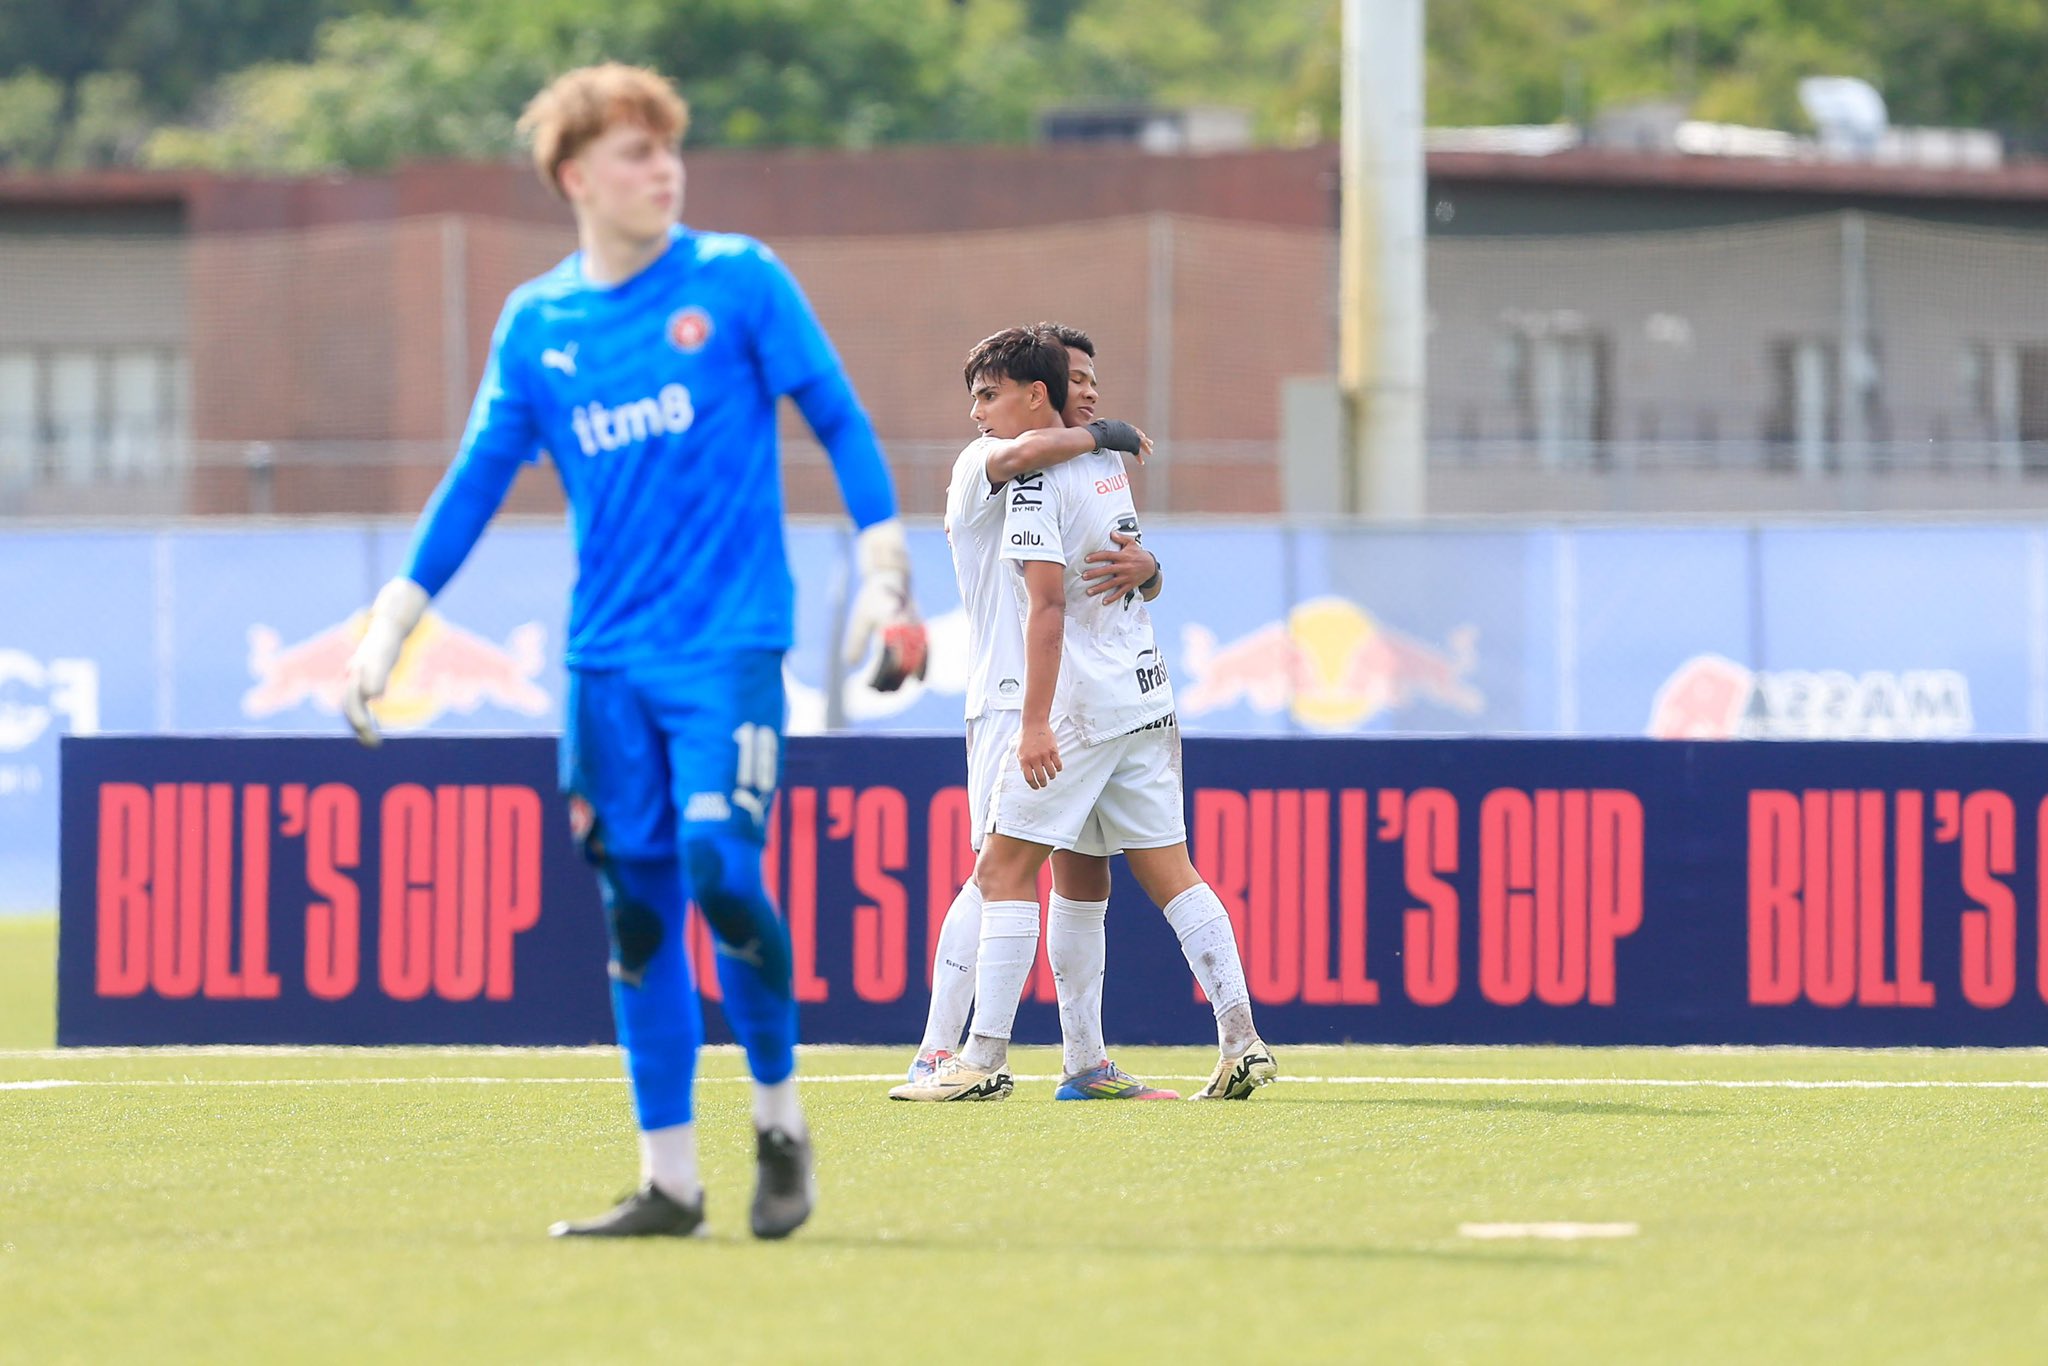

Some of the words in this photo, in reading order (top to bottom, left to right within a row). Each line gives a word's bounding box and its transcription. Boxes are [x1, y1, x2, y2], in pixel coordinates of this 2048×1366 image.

[572, 383, 694, 456] itm8
[97, 782, 361, 1000] BULL'S
[379, 783, 542, 1000] CUP
[1479, 788, 1645, 1006] CUP
[1747, 789, 2017, 1008] BULL'S
